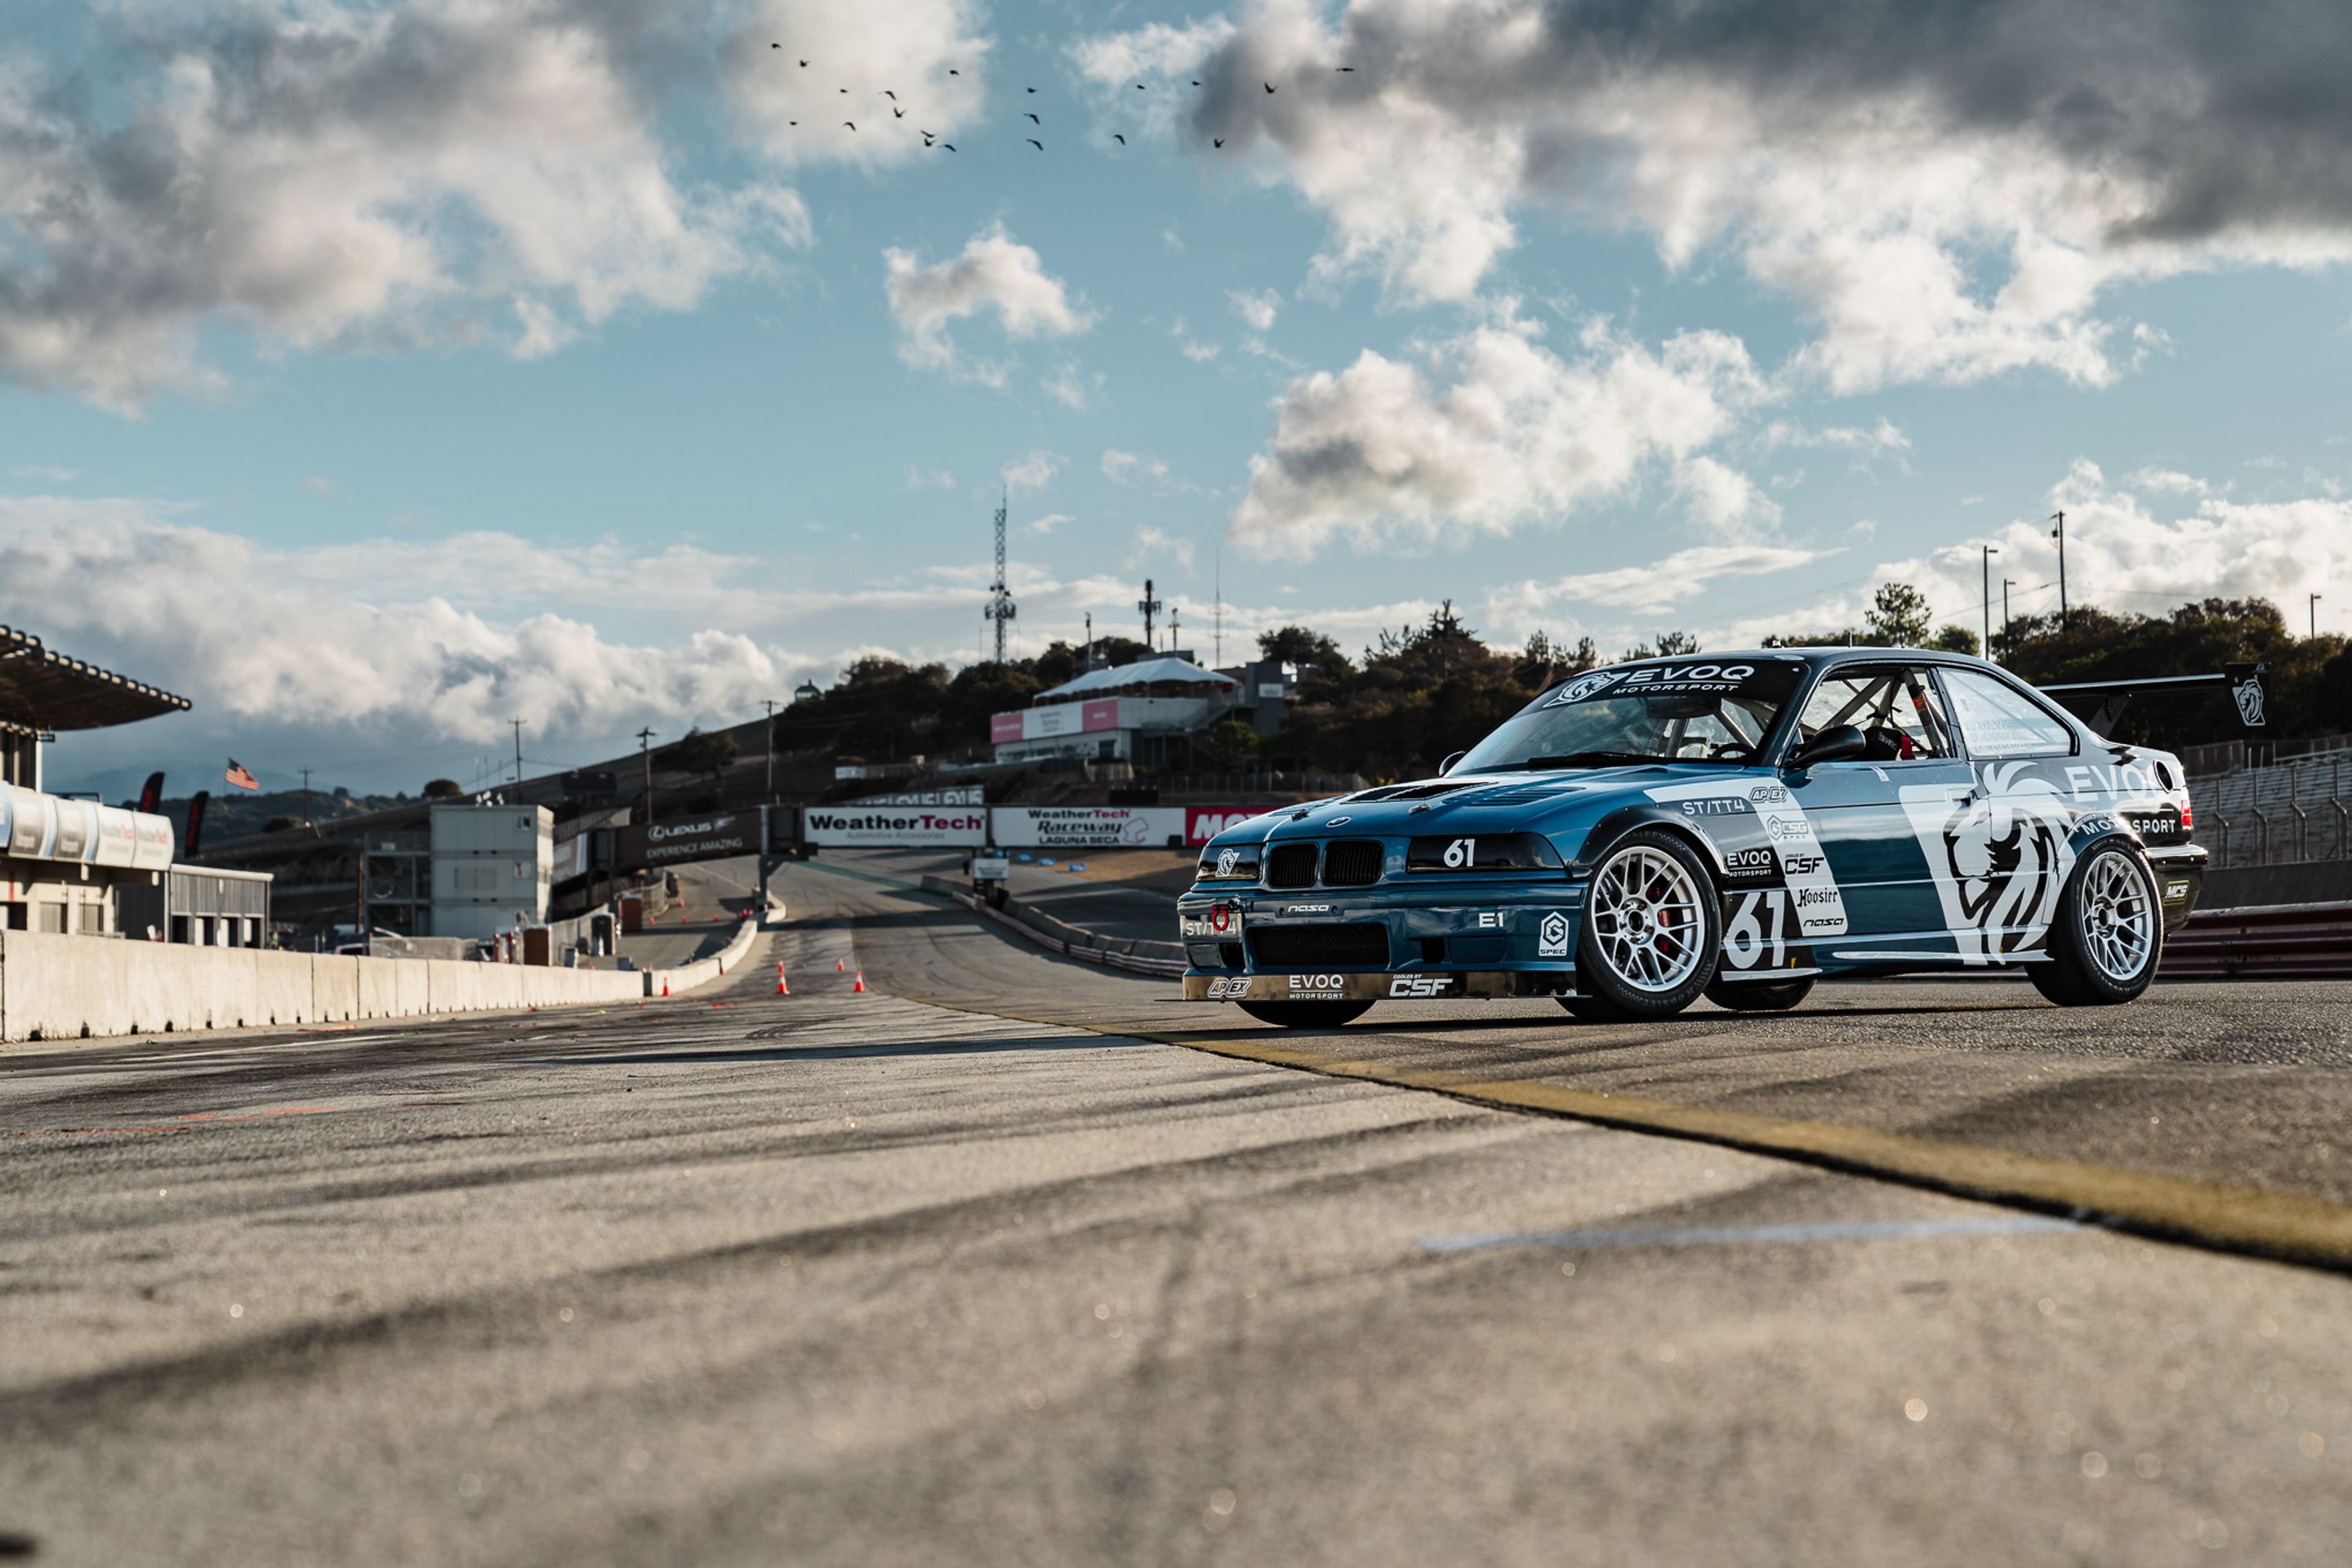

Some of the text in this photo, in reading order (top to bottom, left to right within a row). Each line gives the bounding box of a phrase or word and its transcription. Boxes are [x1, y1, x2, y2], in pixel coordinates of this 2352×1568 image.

[1625, 666, 1755, 684] EVOQ
[1613, 684, 1739, 694] MOTORSPORT
[1028, 808, 1129, 818] WeatherTech
[1682, 800, 1745, 815] ST/TT4
[666, 822, 712, 836] LEXUS
[810, 815, 982, 830] WeatherTech
[1037, 821, 1122, 835] Raceway
[647, 838, 742, 858] EXPERIENCE AMAZING
[1443, 839, 1476, 867] 61
[1727, 851, 1771, 866] EVOQ
[1729, 869, 1772, 878] MOTORSPORT
[1784, 858, 1824, 875] CSF
[1797, 888, 1838, 907] Hoosier
[2166, 884, 2188, 898] MCS
[1479, 912, 1503, 928] E1
[1723, 892, 1785, 969] 61
[1289, 974, 1343, 989] EVOQ
[1389, 978, 1453, 996] CSF
